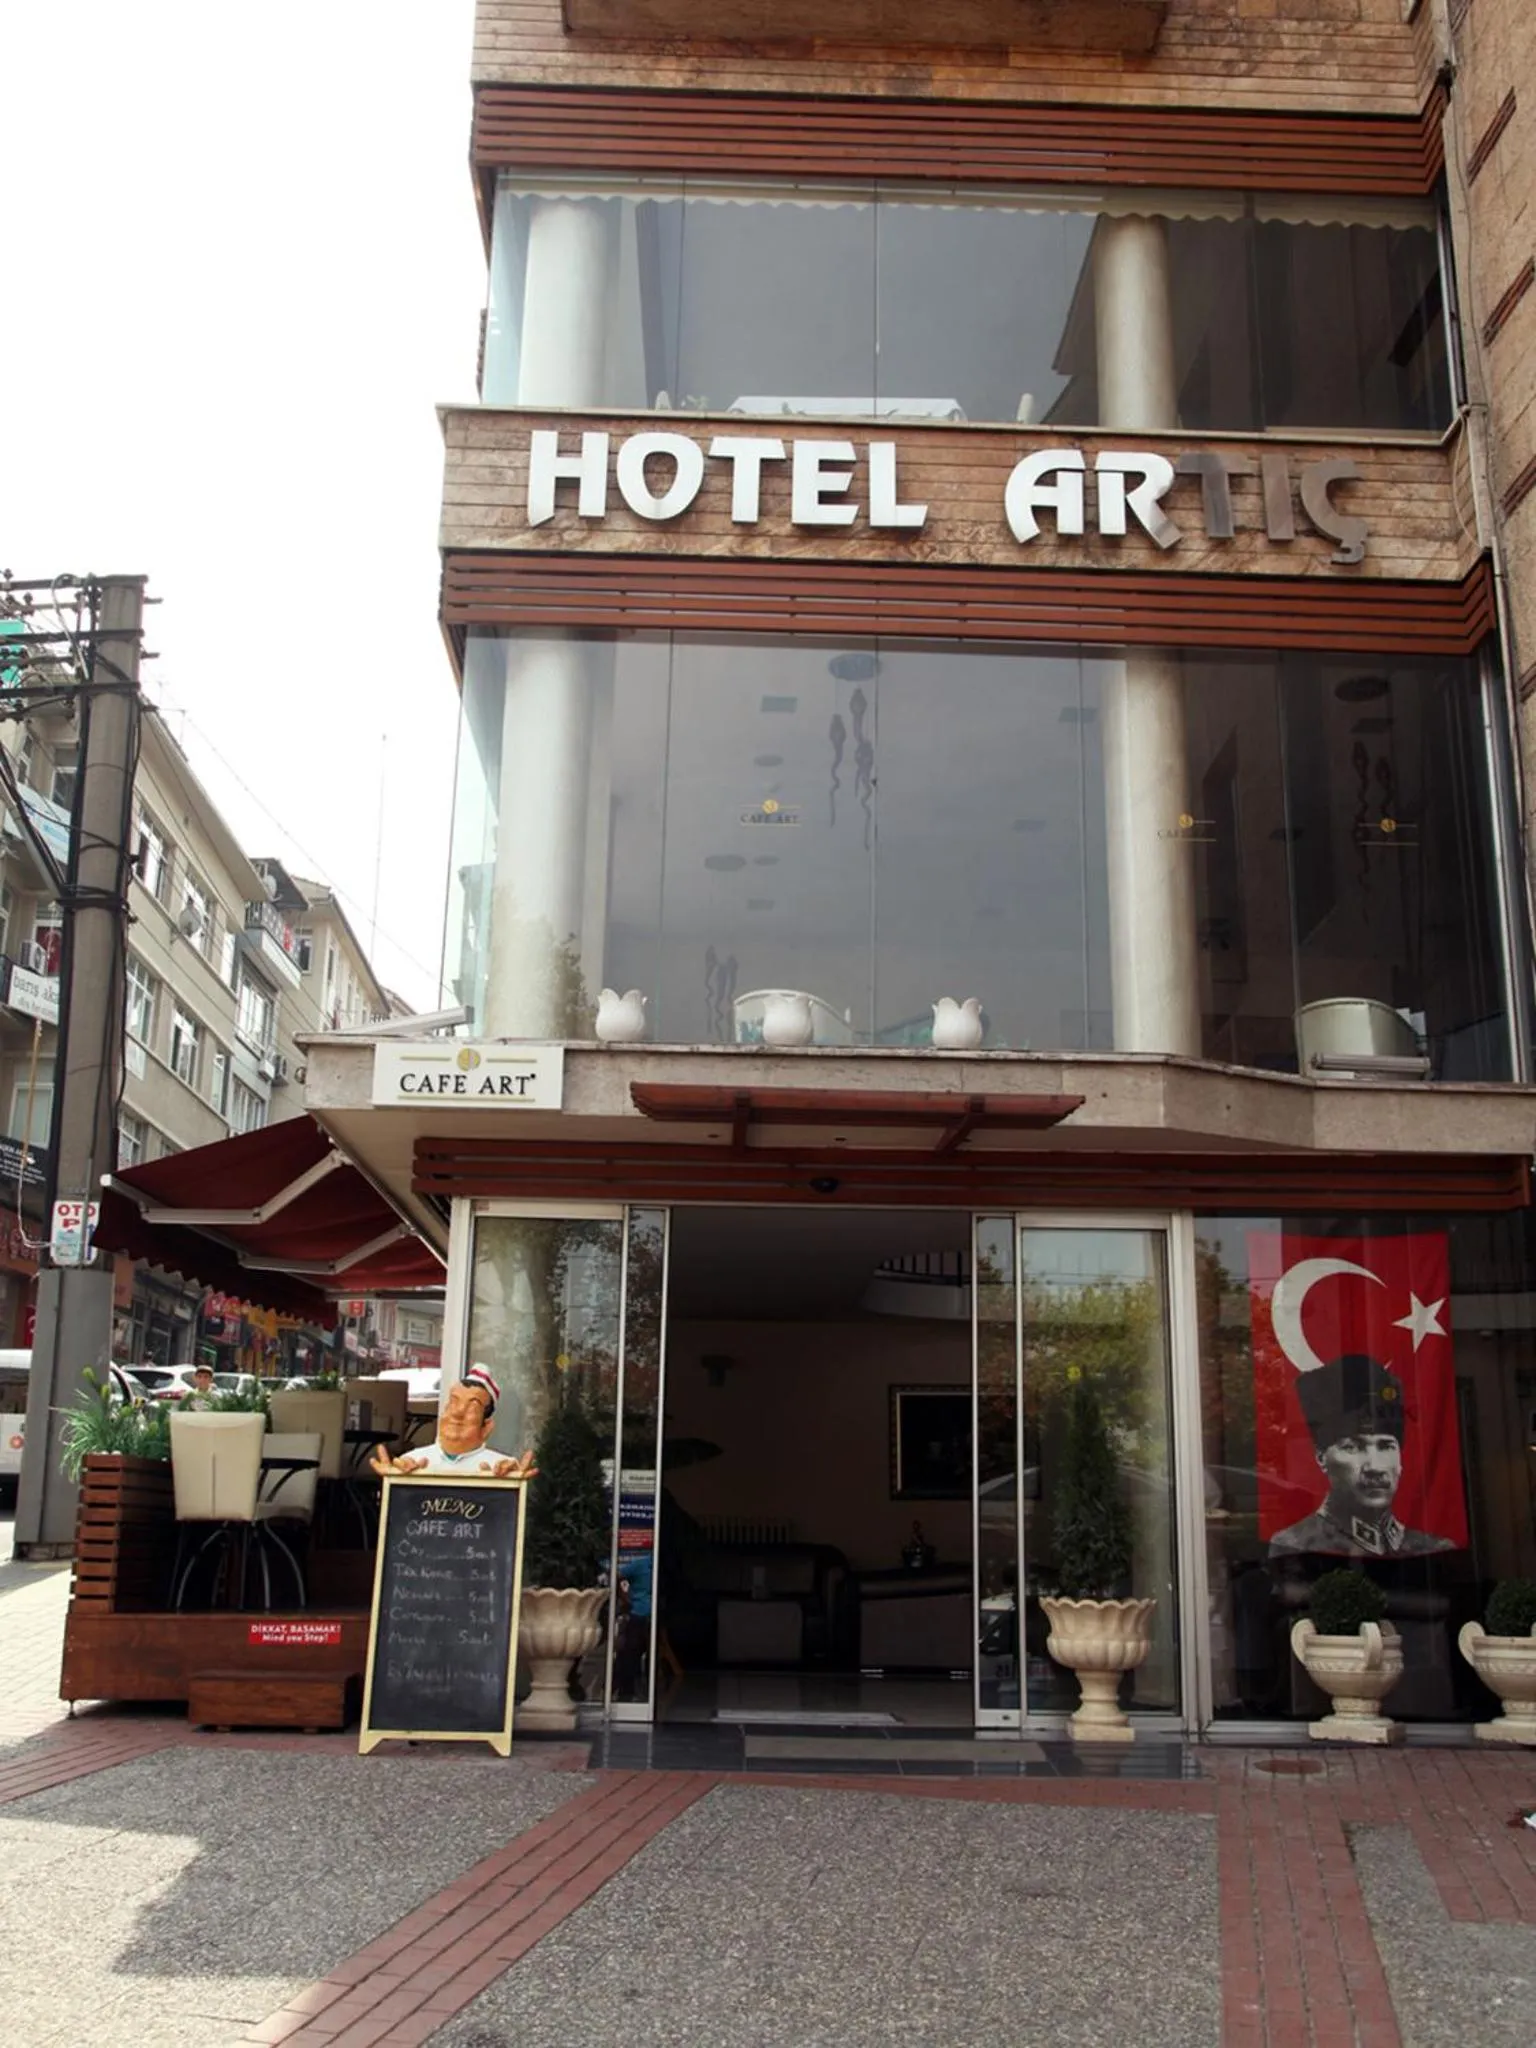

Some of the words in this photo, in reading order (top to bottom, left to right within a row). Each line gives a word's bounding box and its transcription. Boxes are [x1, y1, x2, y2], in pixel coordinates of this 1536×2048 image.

[528, 430, 928, 527] HOTEL
[400, 1073, 467, 1094] CAFE
[57, 1204, 96, 1217] OTO
[421, 1498, 484, 1519] MENU
[406, 1520, 448, 1537] CAFE
[453, 1523, 484, 1538] ART
